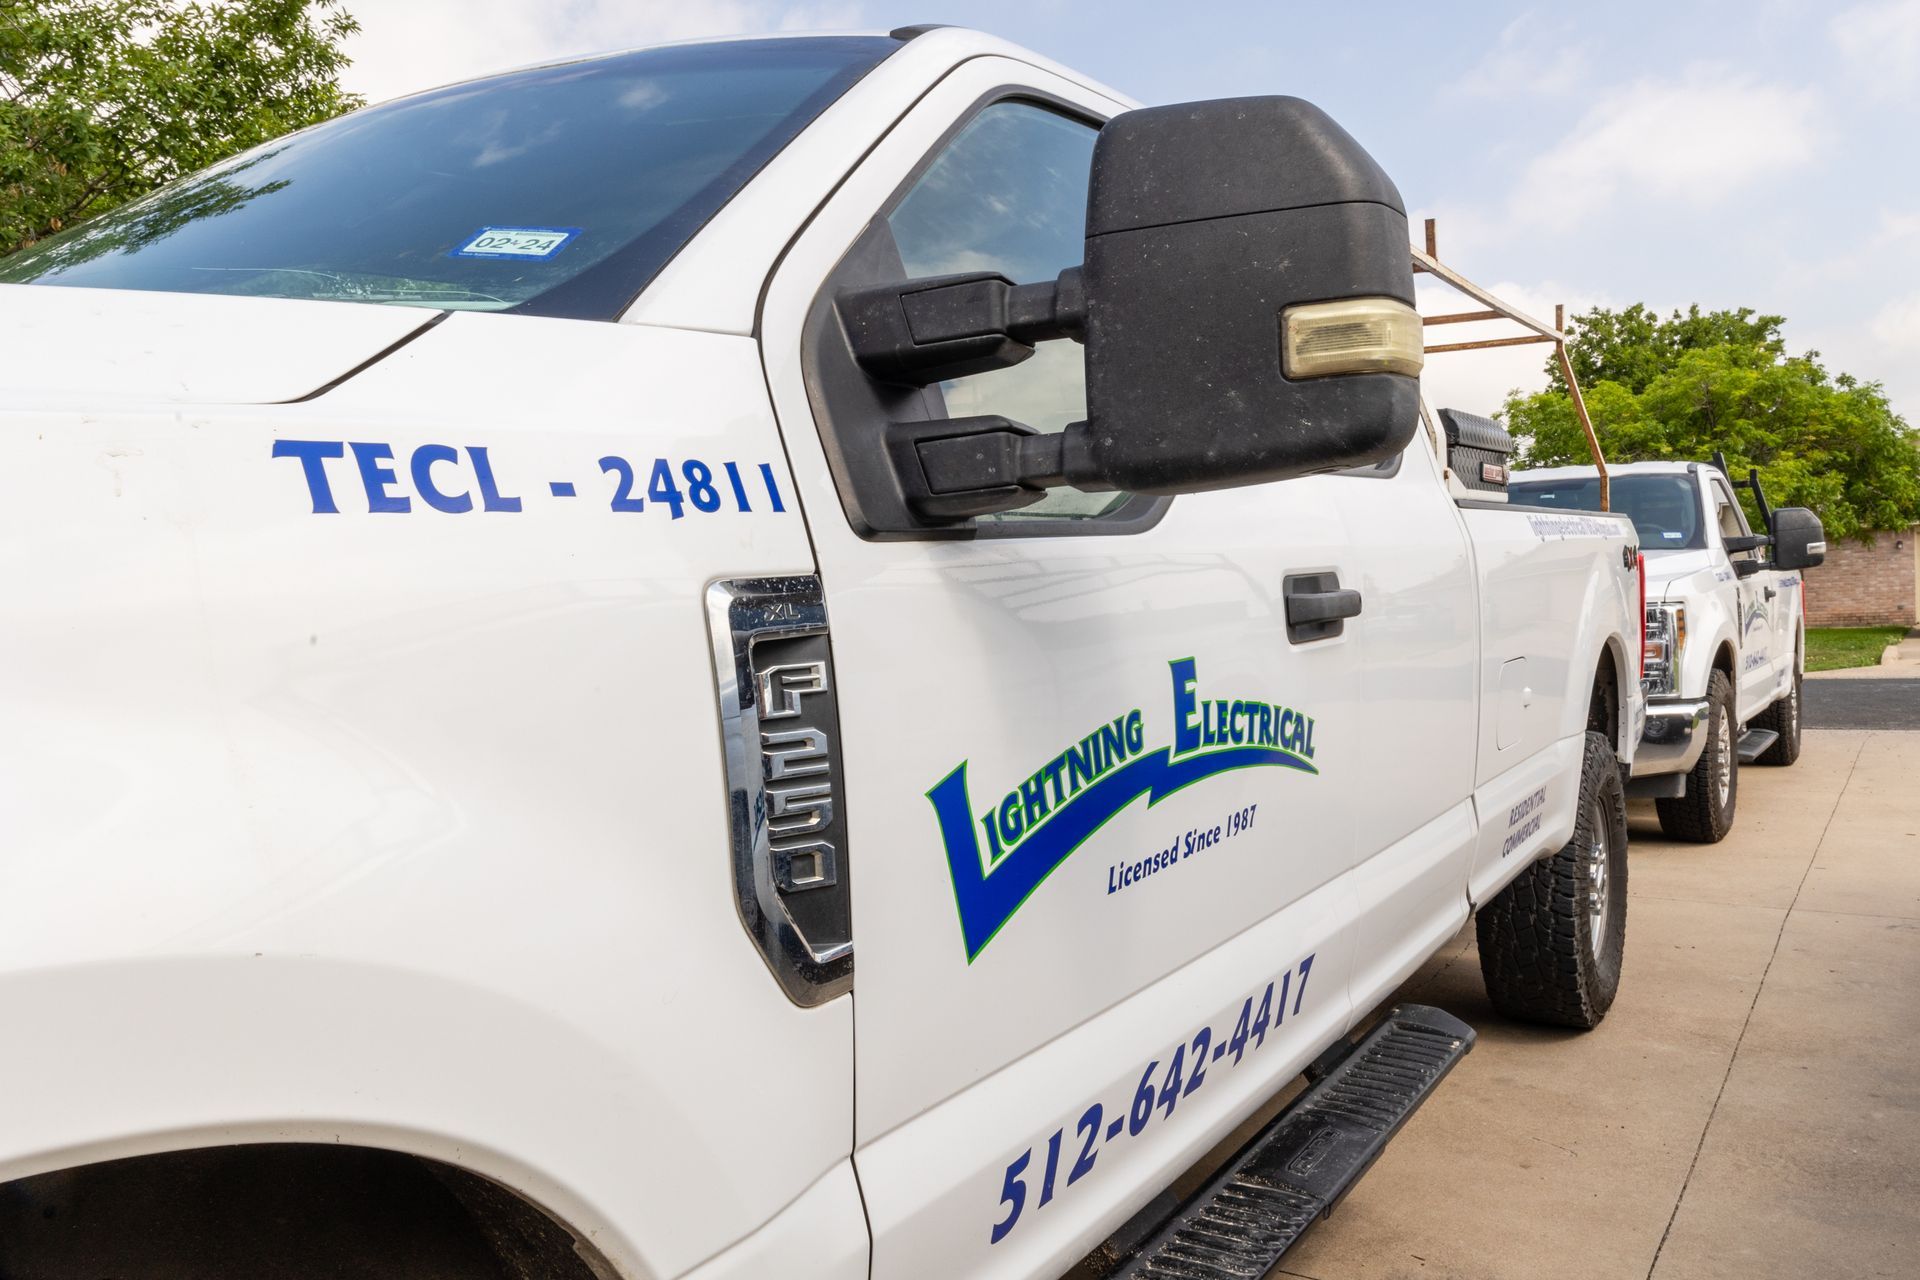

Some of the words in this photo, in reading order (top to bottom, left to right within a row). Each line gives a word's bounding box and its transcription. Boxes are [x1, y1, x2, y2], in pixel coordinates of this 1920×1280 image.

[272, 440, 522, 514] TECL
[549, 482, 577, 497] -
[598, 456, 786, 520] 24811
[762, 603, 800, 621] XL
[925, 709, 1144, 966] LIGHTNING
[1168, 656, 1316, 760] ELECTRICAL
[1502, 812, 1543, 858] COMMERCIAL
[1508, 785, 1547, 829] RESIDENTIAL
[1108, 836, 1179, 895] Licensed
[1184, 824, 1221, 859] Since
[1226, 804, 1257, 837] 1987
[991, 953, 1316, 1245] 512-642-4417
